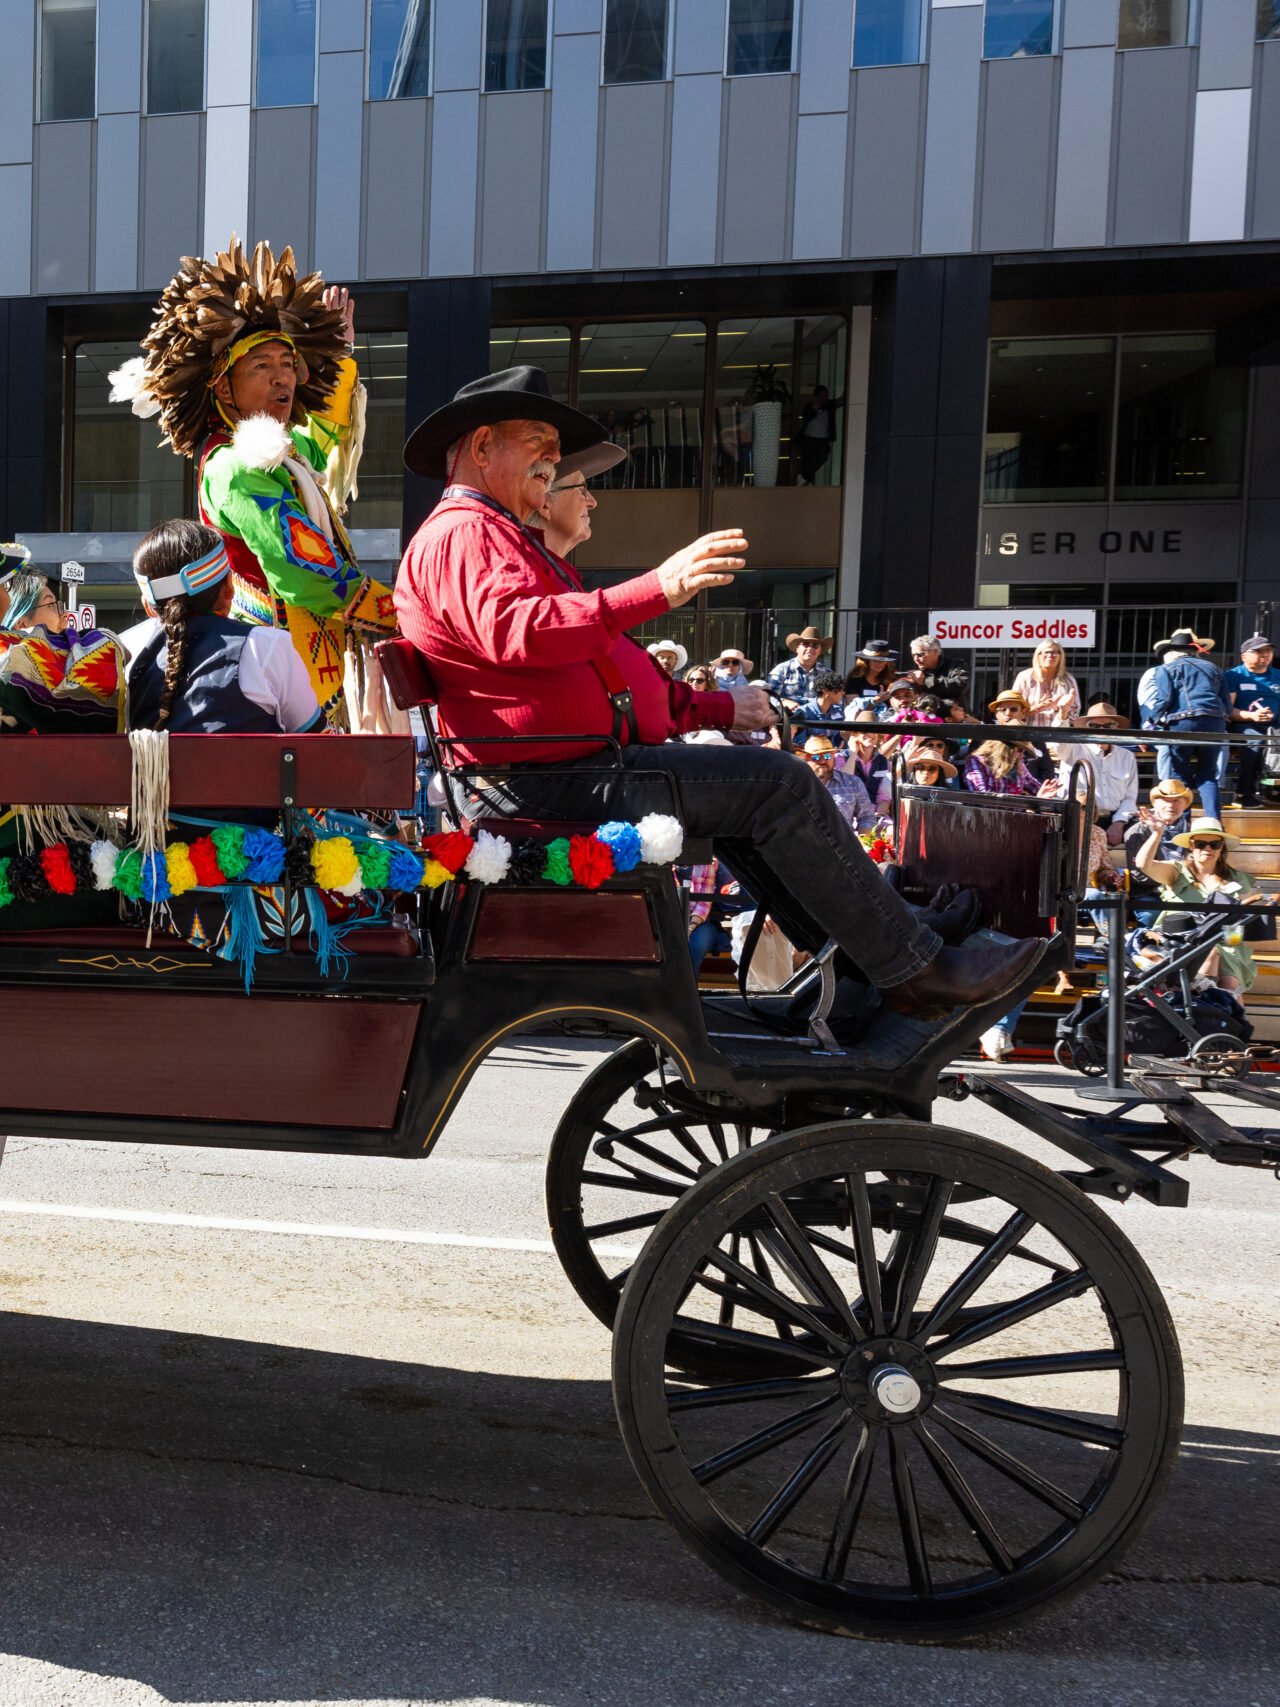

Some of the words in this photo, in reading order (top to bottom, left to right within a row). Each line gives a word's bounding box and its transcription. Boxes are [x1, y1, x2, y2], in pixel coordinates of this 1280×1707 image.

[1098, 530, 1182, 554] ONE
[66, 567, 81, 578] 2654
[935, 620, 1004, 640] Suncor
[1011, 619, 1088, 639] Saddles
